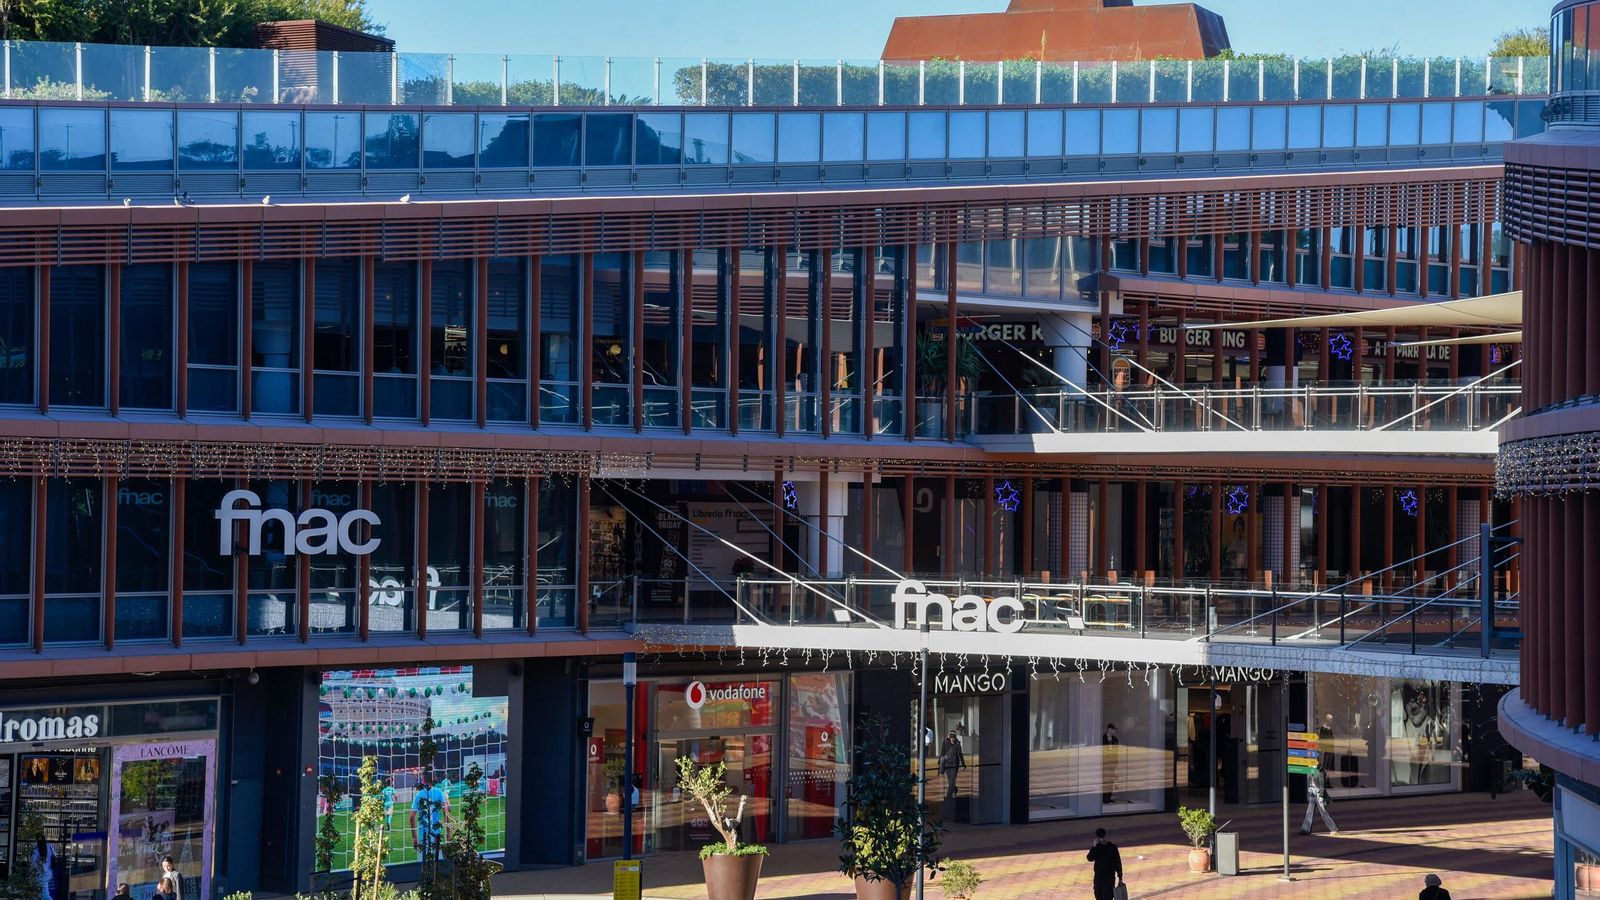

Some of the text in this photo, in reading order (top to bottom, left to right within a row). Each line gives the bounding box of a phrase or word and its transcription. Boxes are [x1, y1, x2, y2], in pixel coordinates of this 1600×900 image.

[1159, 327, 1211, 346] BUGER
[1222, 330, 1246, 348] ING
[118, 487, 163, 505] fnac
[311, 489, 351, 506] fnac
[214, 489, 382, 556] fnac
[890, 579, 1025, 633] fnac
[934, 672, 1006, 694] MANGO
[1213, 666, 1274, 682] MANGO
[709, 684, 766, 701] vodafone
[0, 712, 99, 743] romas
